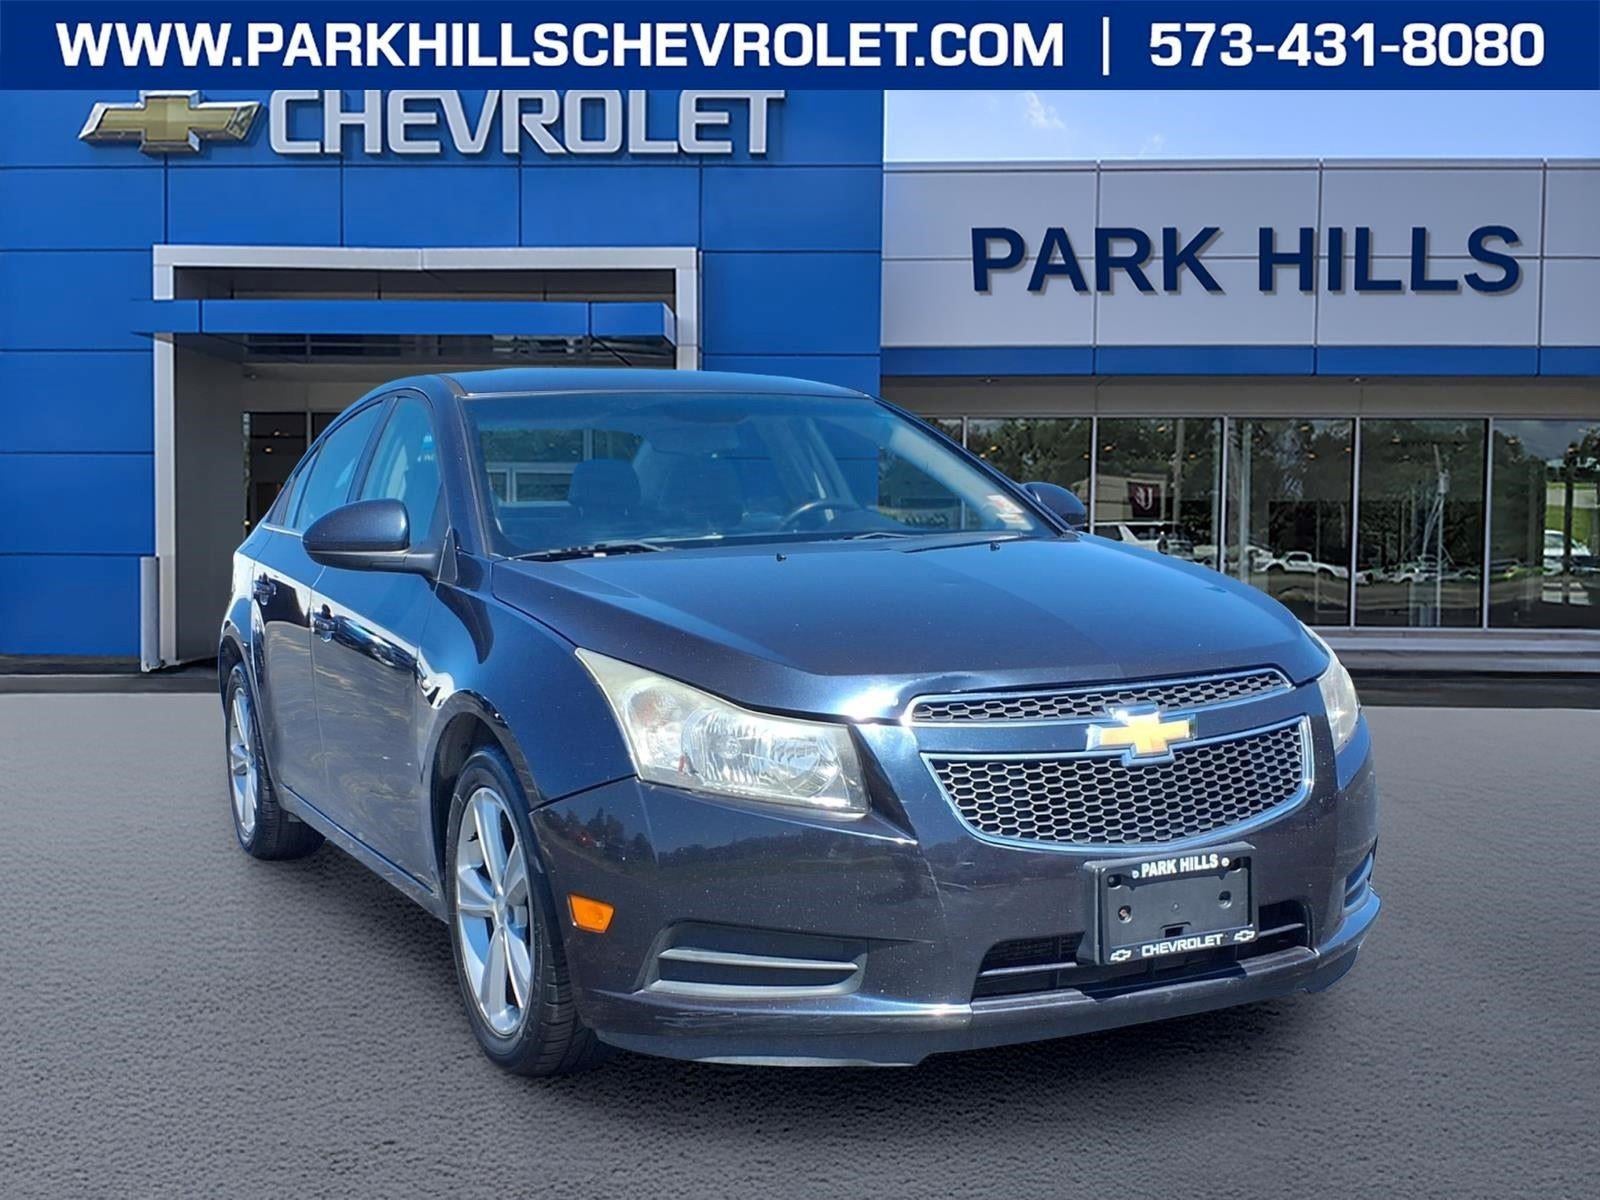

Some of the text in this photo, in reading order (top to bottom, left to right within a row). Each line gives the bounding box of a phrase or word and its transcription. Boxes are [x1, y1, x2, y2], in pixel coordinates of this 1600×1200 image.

[270, 90, 784, 153] CHEVROLET
[971, 225, 1523, 292] PARK HILLS
[1141, 853, 1219, 878] PARK HILLS
[1142, 933, 1224, 957] CHEVROLET
